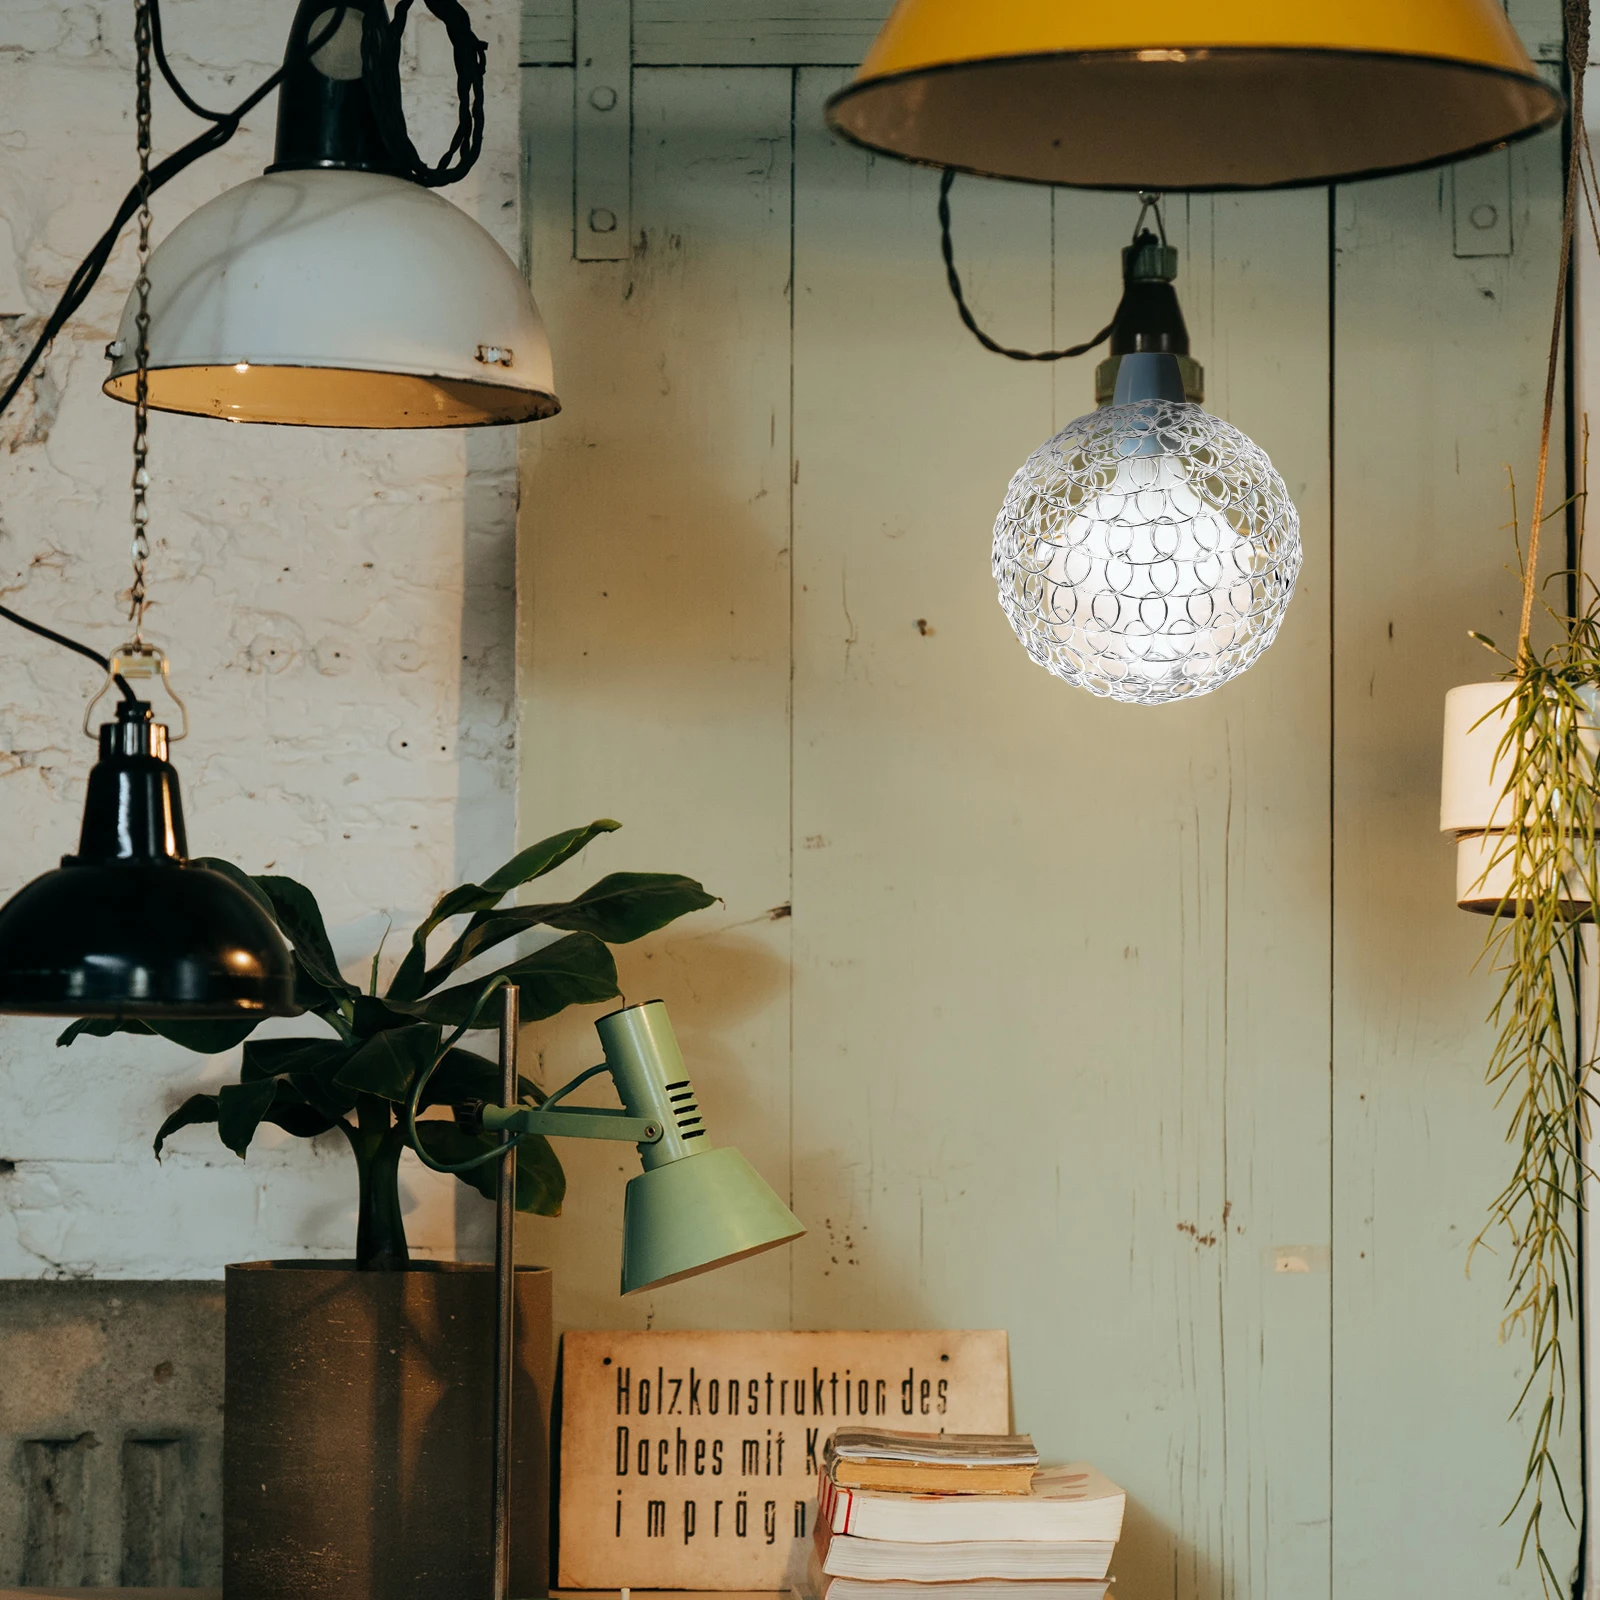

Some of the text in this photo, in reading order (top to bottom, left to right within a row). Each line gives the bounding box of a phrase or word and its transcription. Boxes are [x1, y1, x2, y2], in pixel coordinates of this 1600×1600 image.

[616, 1366, 949, 1416] Holzkonstruktion des
[616, 1426, 723, 1476] Daches
[741, 1429, 786, 1477] mit
